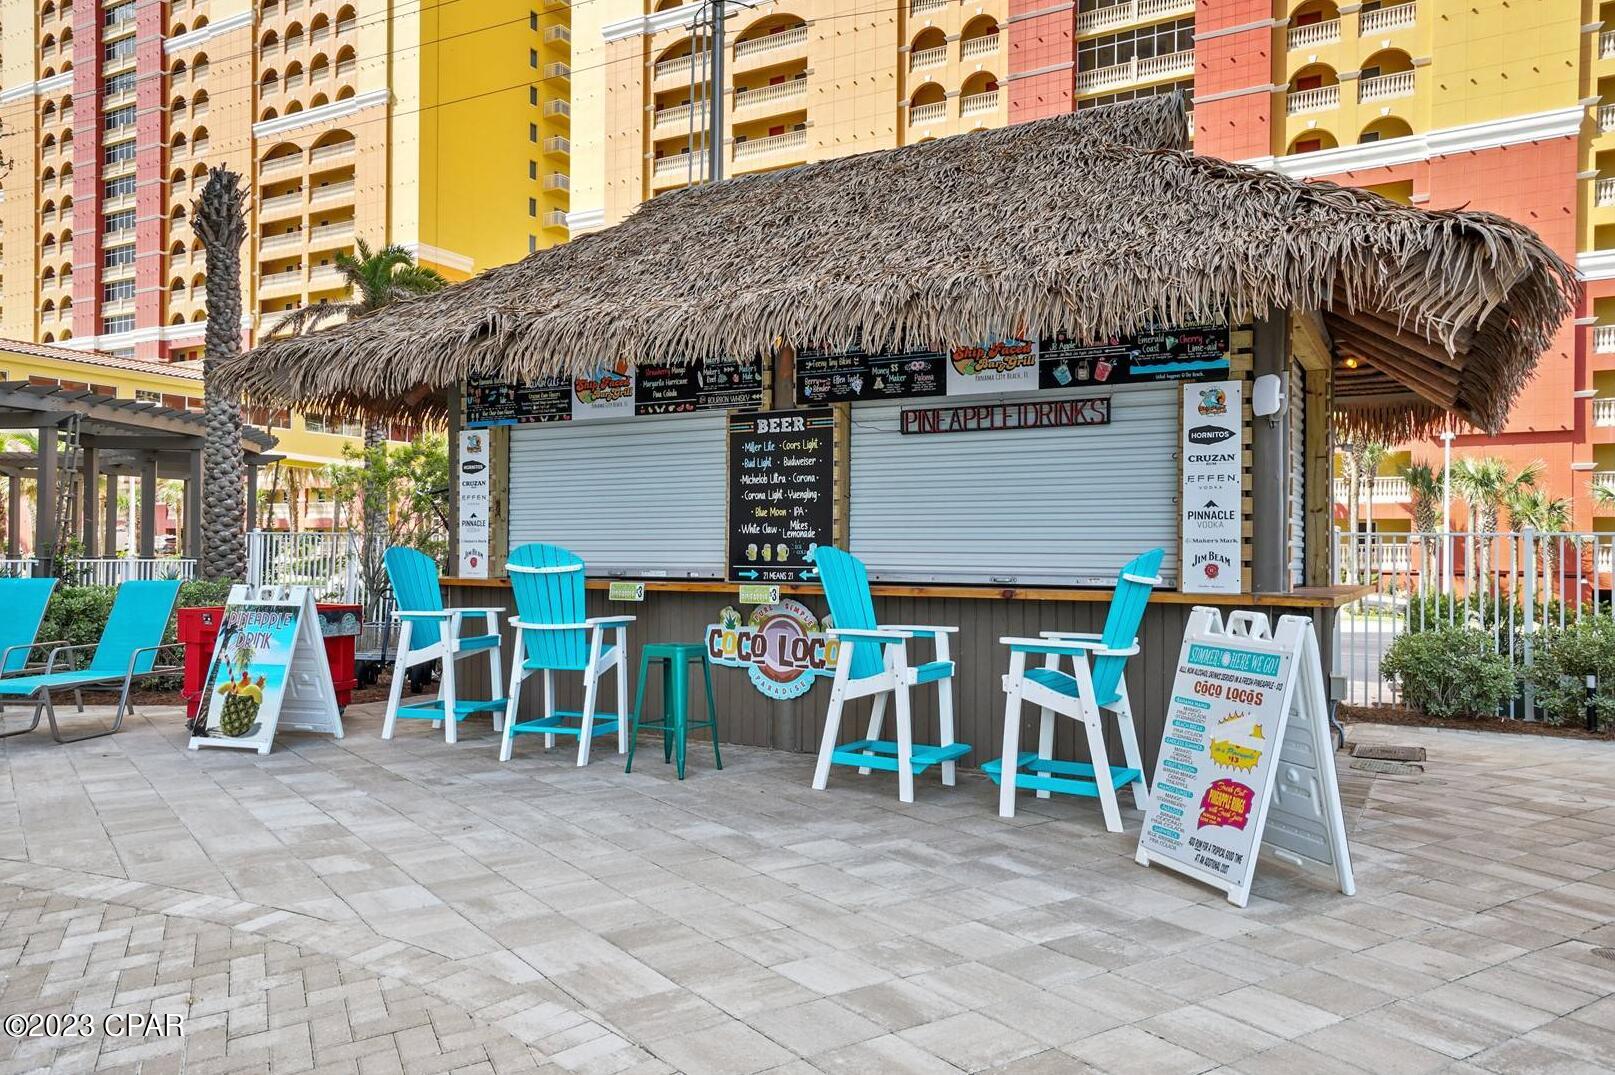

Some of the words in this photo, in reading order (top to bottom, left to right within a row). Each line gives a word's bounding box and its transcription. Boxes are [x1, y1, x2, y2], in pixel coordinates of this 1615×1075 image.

[1138, 335, 1164, 344] Emerald
[1179, 334, 1202, 344] Cherry
[953, 345, 984, 360] Ship
[987, 342, 1032, 358] Faced
[1142, 344, 1160, 352] Coast
[974, 358, 999, 371] Bar
[1003, 356, 1036, 371] Grill
[671, 366, 686, 376] Mango
[872, 366, 890, 378] Money
[642, 379, 665, 388] Margarita
[914, 374, 934, 382] Paloma
[904, 406, 1014, 432] PINEAPPLE
[1023, 400, 1105, 426] DRINKS
[757, 417, 805, 433] BEER
[745, 441, 761, 453] Miller
[764, 441, 775, 451] Lite
[782, 440, 800, 450] Coors
[803, 438, 818, 452] Light
[744, 457, 756, 468] Bud
[757, 457, 772, 471] Light
[783, 455, 816, 466] Budweiser
[1188, 454, 1235, 463] CRUZAN
[742, 473, 767, 484] Michelob
[770, 472, 786, 483] Ultra
[792, 473, 815, 482] Corona
[1188, 474, 1236, 483] EFFEN
[744, 490, 766, 500] Corona
[768, 489, 783, 503] Light
[787, 488, 818, 502] Yuengling
[755, 506, 768, 517] Blue
[770, 507, 787, 517] Moon
[794, 507, 804, 516] IPA
[1187, 510, 1235, 520] PINNACLE
[742, 524, 760, 534] White
[762, 523, 777, 534] Claw
[790, 519, 808, 530] Mikes
[782, 529, 816, 538] Lemonade
[1192, 552, 1207, 567] JIM
[1208, 551, 1231, 566] BEAM
[227, 611, 293, 630] PINEAPPLE
[754, 605, 773, 622] PURE
[784, 603, 814, 627] SIMPLE
[236, 631, 272, 649] DRINK
[709, 629, 767, 661] COCO
[778, 635, 840, 669] LOCO
[1229, 652, 1251, 670] HERE
[1249, 655, 1264, 671] WE
[1262, 656, 1279, 674] GO!
[755, 674, 805, 694] PARADISE
[1194, 680, 1222, 698] COCO
[1226, 687, 1264, 706] LOCOS
